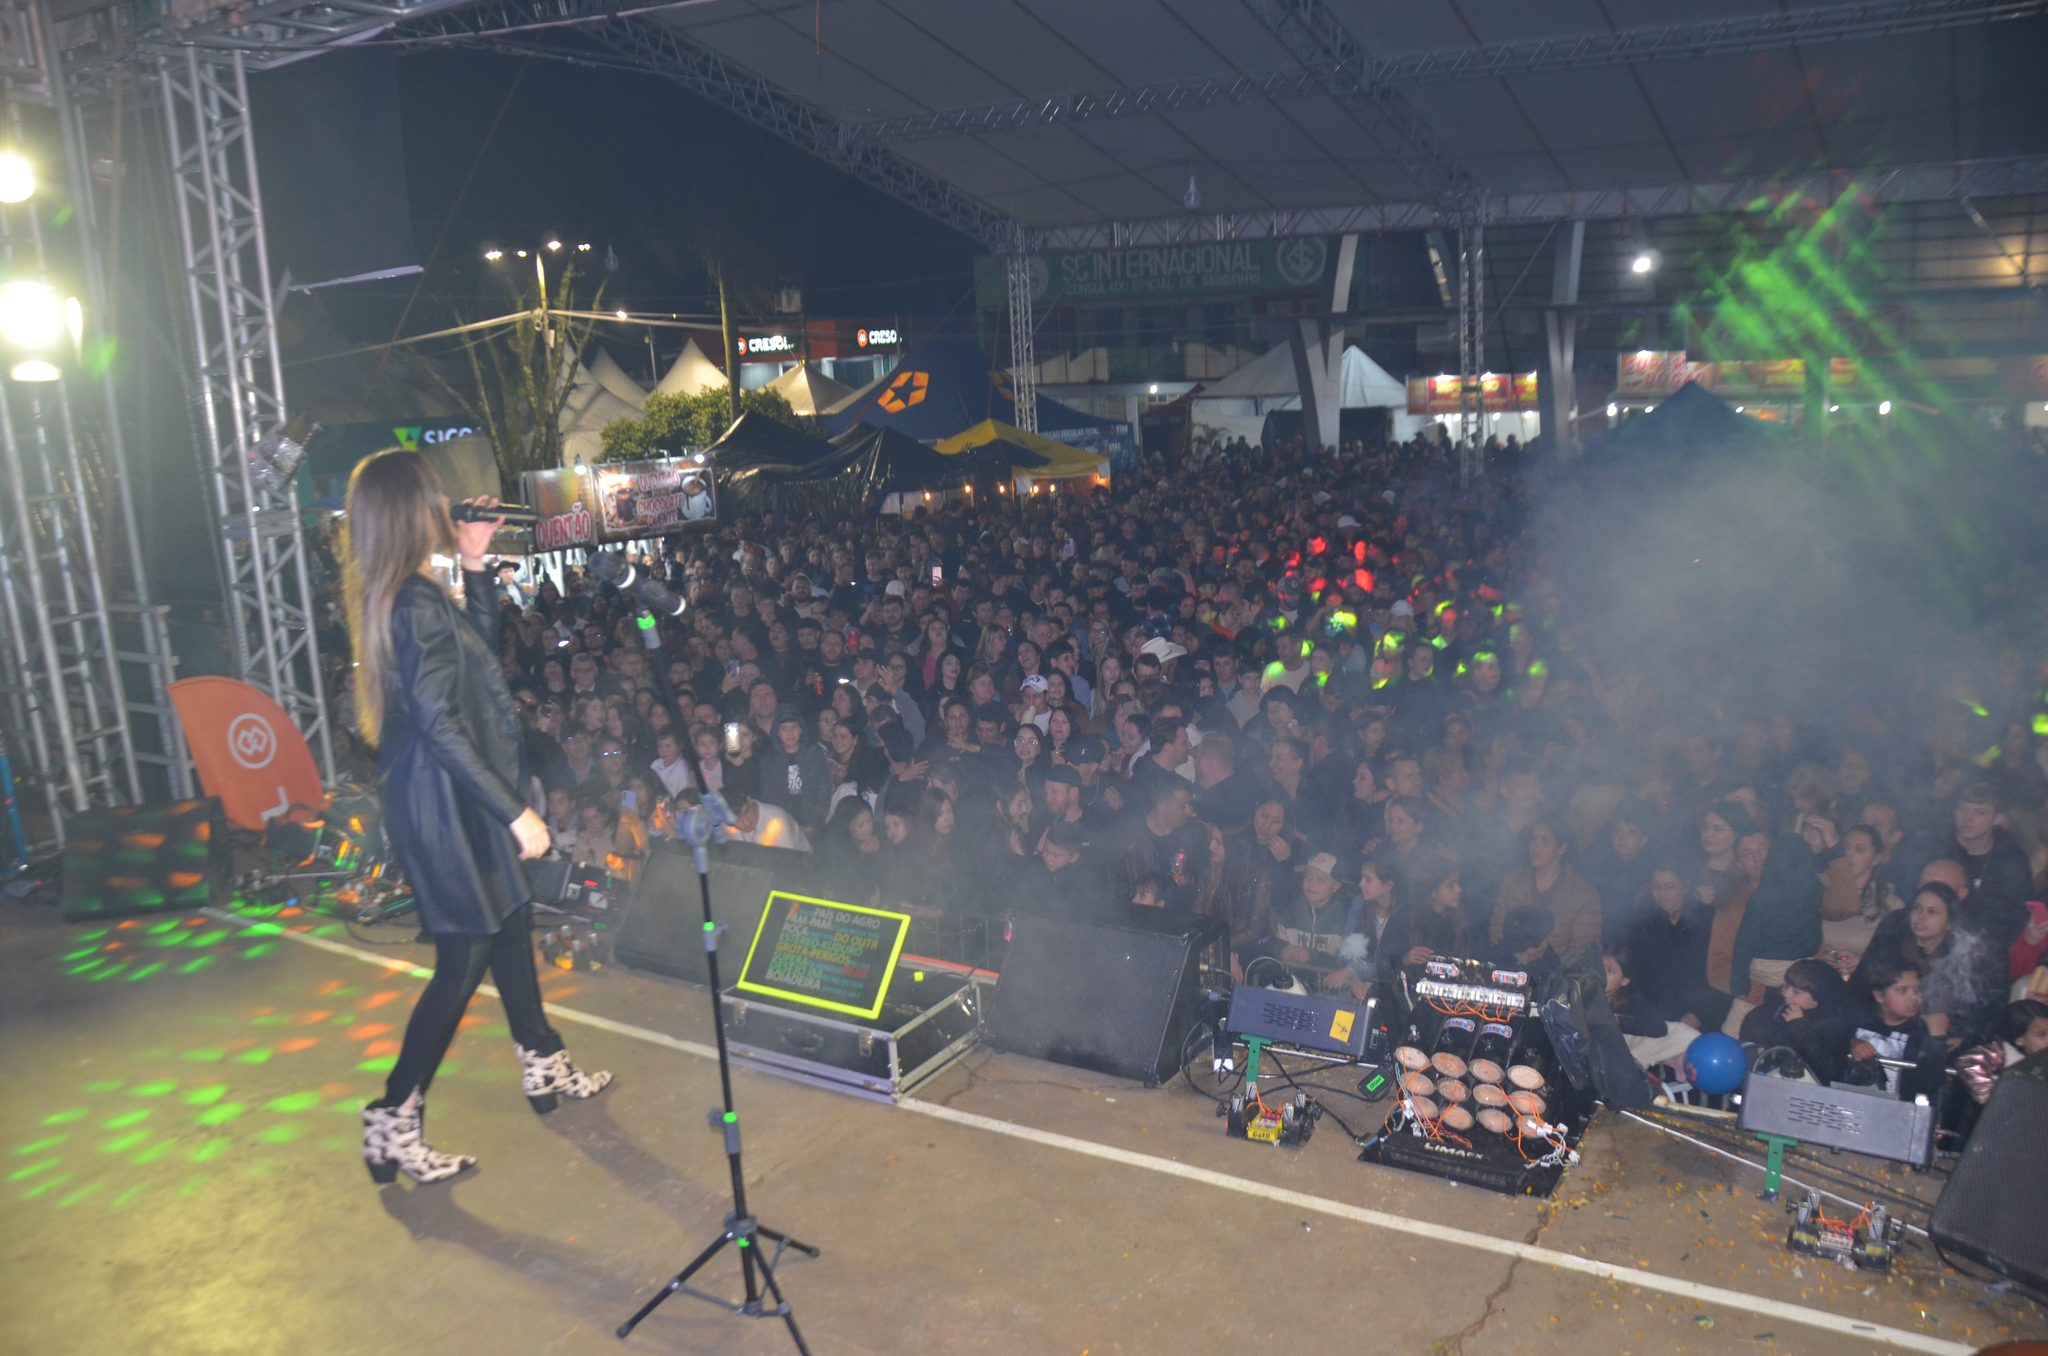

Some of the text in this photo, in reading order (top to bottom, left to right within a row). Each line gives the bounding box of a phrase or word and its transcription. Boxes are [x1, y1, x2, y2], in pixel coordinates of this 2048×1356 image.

[1093, 243, 1261, 280] INTERNACIONAL
[869, 329, 902, 345] CRESO
[535, 501, 592, 551] QUENTÃO
[835, 911, 851, 924] DO
[851, 915, 881, 929] AGRO
[765, 968, 822, 990] BOIADEIRA
